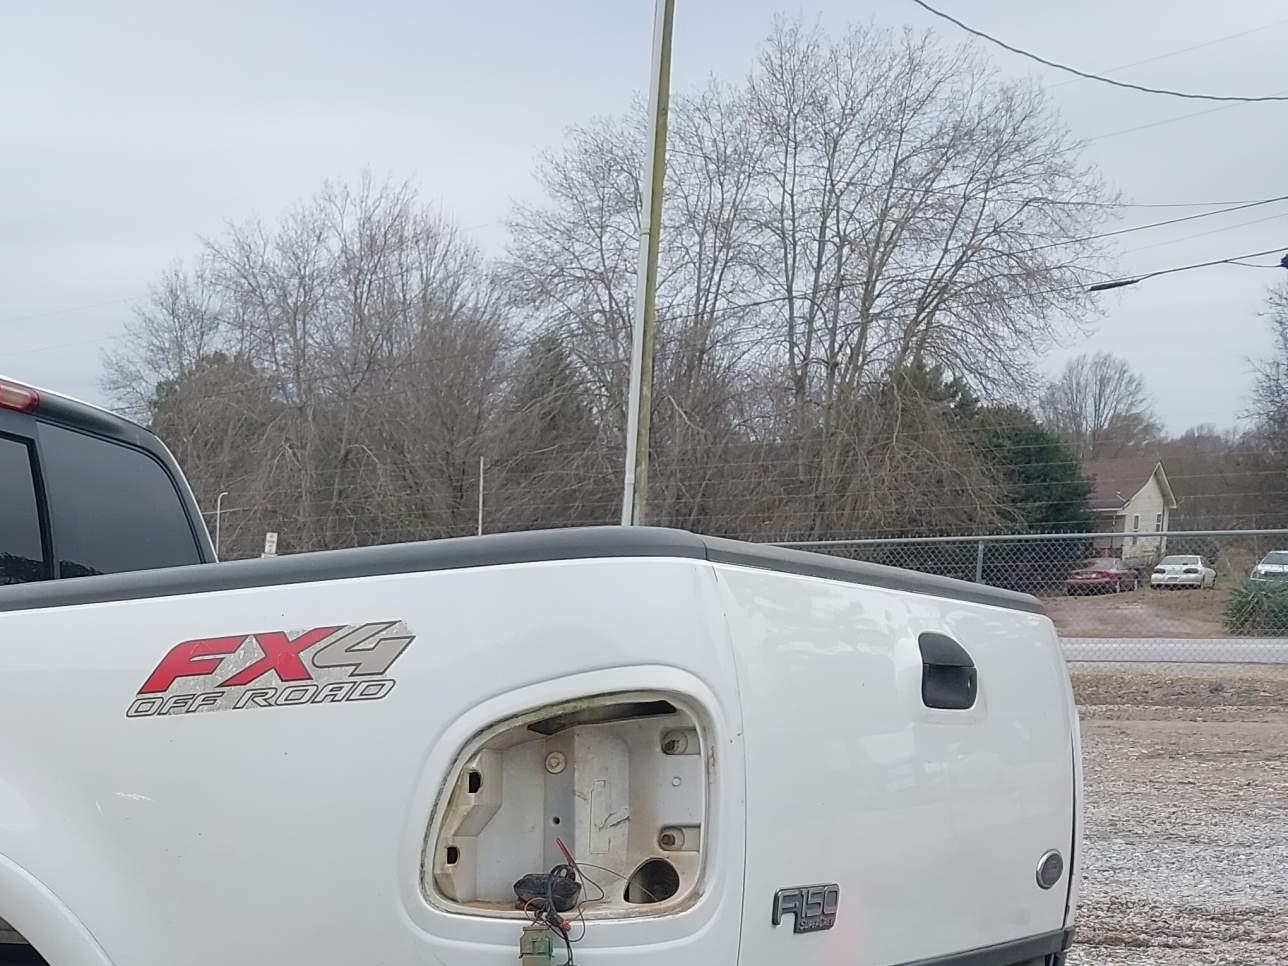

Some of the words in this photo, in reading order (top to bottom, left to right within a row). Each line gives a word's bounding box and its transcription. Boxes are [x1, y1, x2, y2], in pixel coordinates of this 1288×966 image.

[136, 620, 416, 695] FX4
[126, 690, 224, 718] OFF
[232, 678, 397, 710] ROAD
